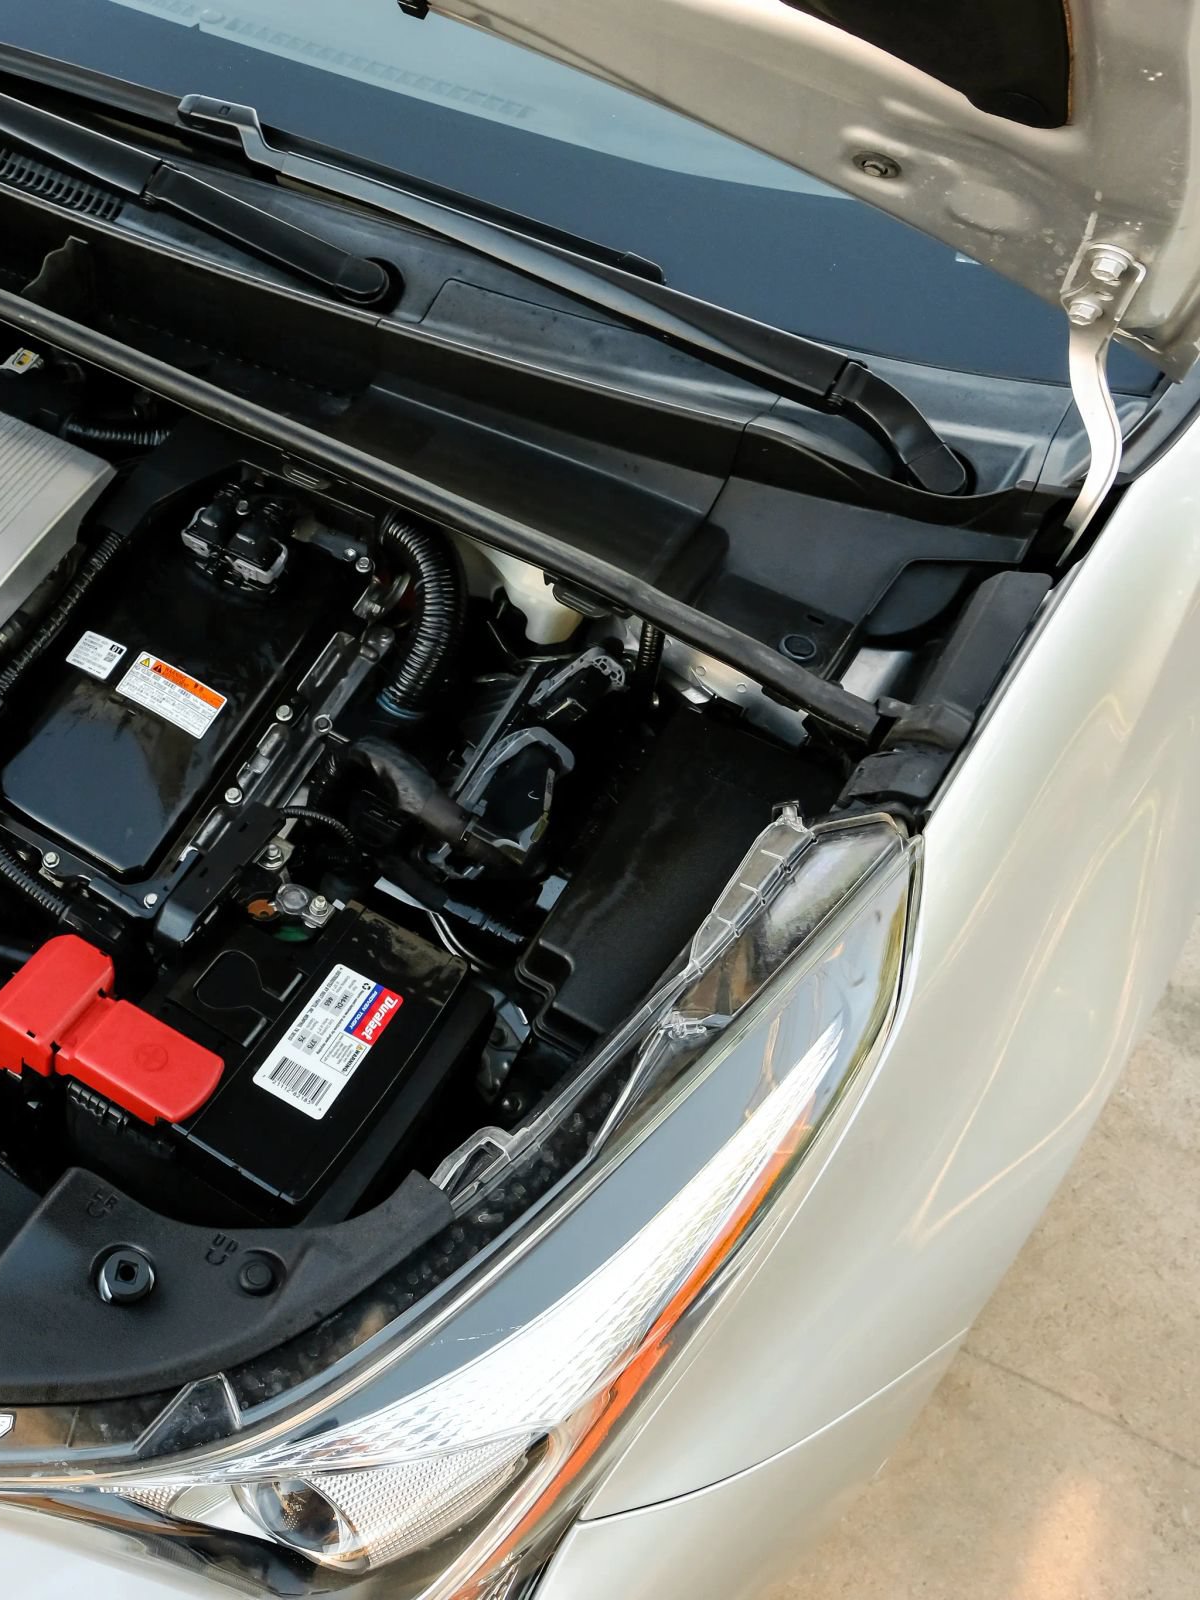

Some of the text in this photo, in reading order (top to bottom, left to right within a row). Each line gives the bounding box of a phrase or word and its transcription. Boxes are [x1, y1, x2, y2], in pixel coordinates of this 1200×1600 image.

[349, 990, 378, 1030] PROVEN TOUGH
[361, 995, 399, 1041] Duralast
[298, 1035, 306, 1043] 75
[307, 1039, 317, 1049] 375
